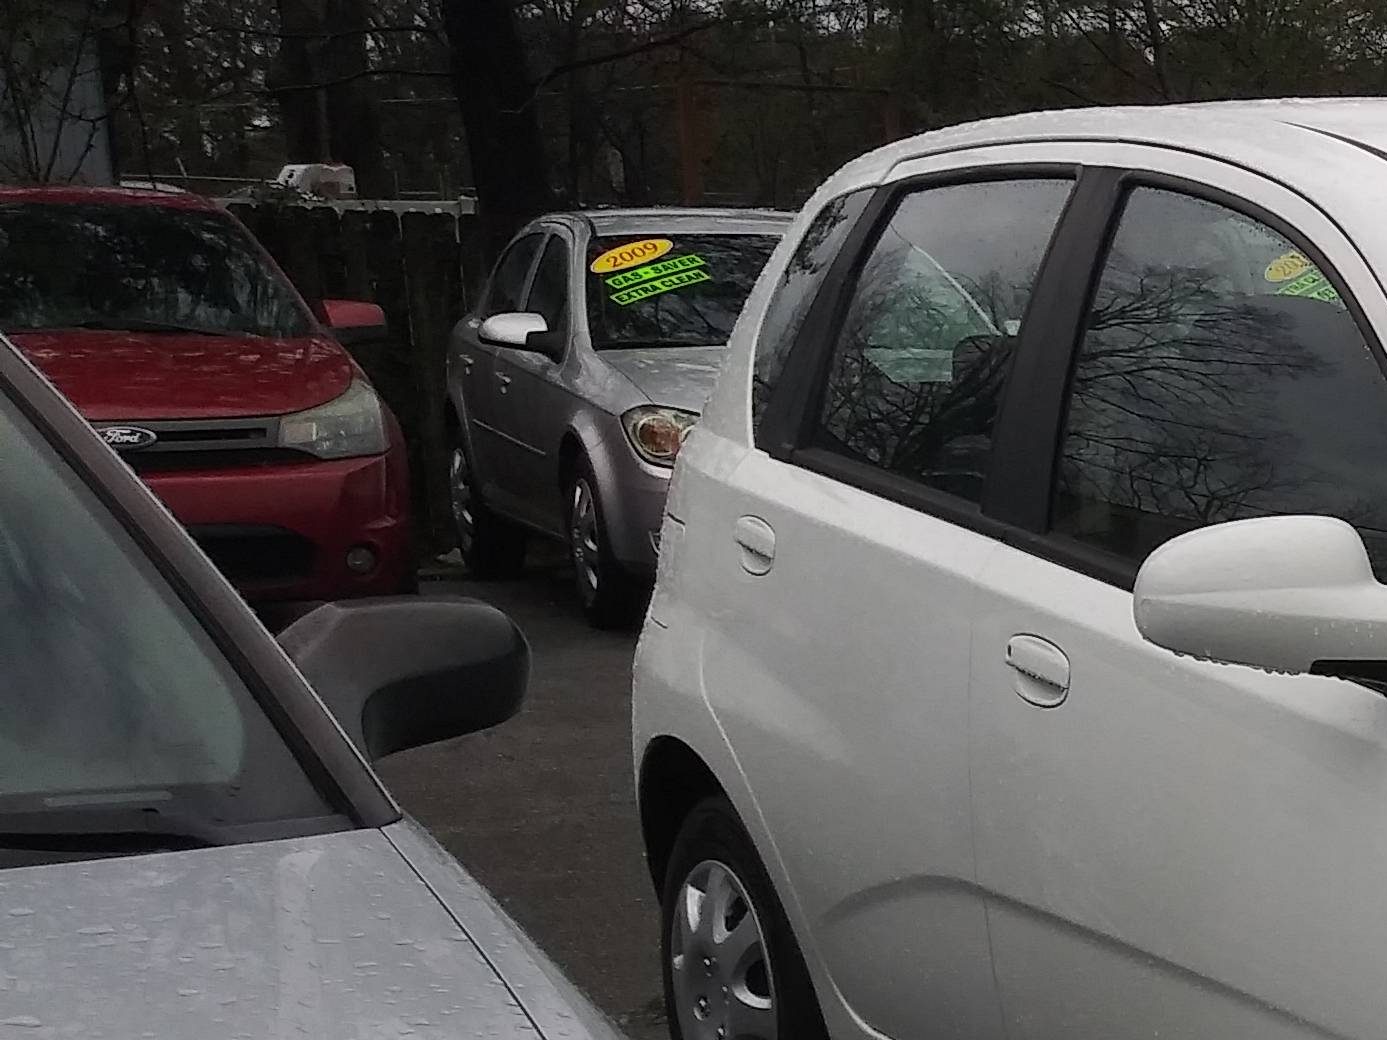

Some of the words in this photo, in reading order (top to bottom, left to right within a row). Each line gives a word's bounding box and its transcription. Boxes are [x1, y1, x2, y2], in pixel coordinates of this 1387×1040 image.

[606, 241, 658, 268] 2009
[611, 271, 643, 286] GAS
[650, 256, 701, 274] SAVER
[615, 284, 662, 302] EXTRA
[660, 272, 705, 288] CLEAN
[103, 429, 141, 443] Ford
